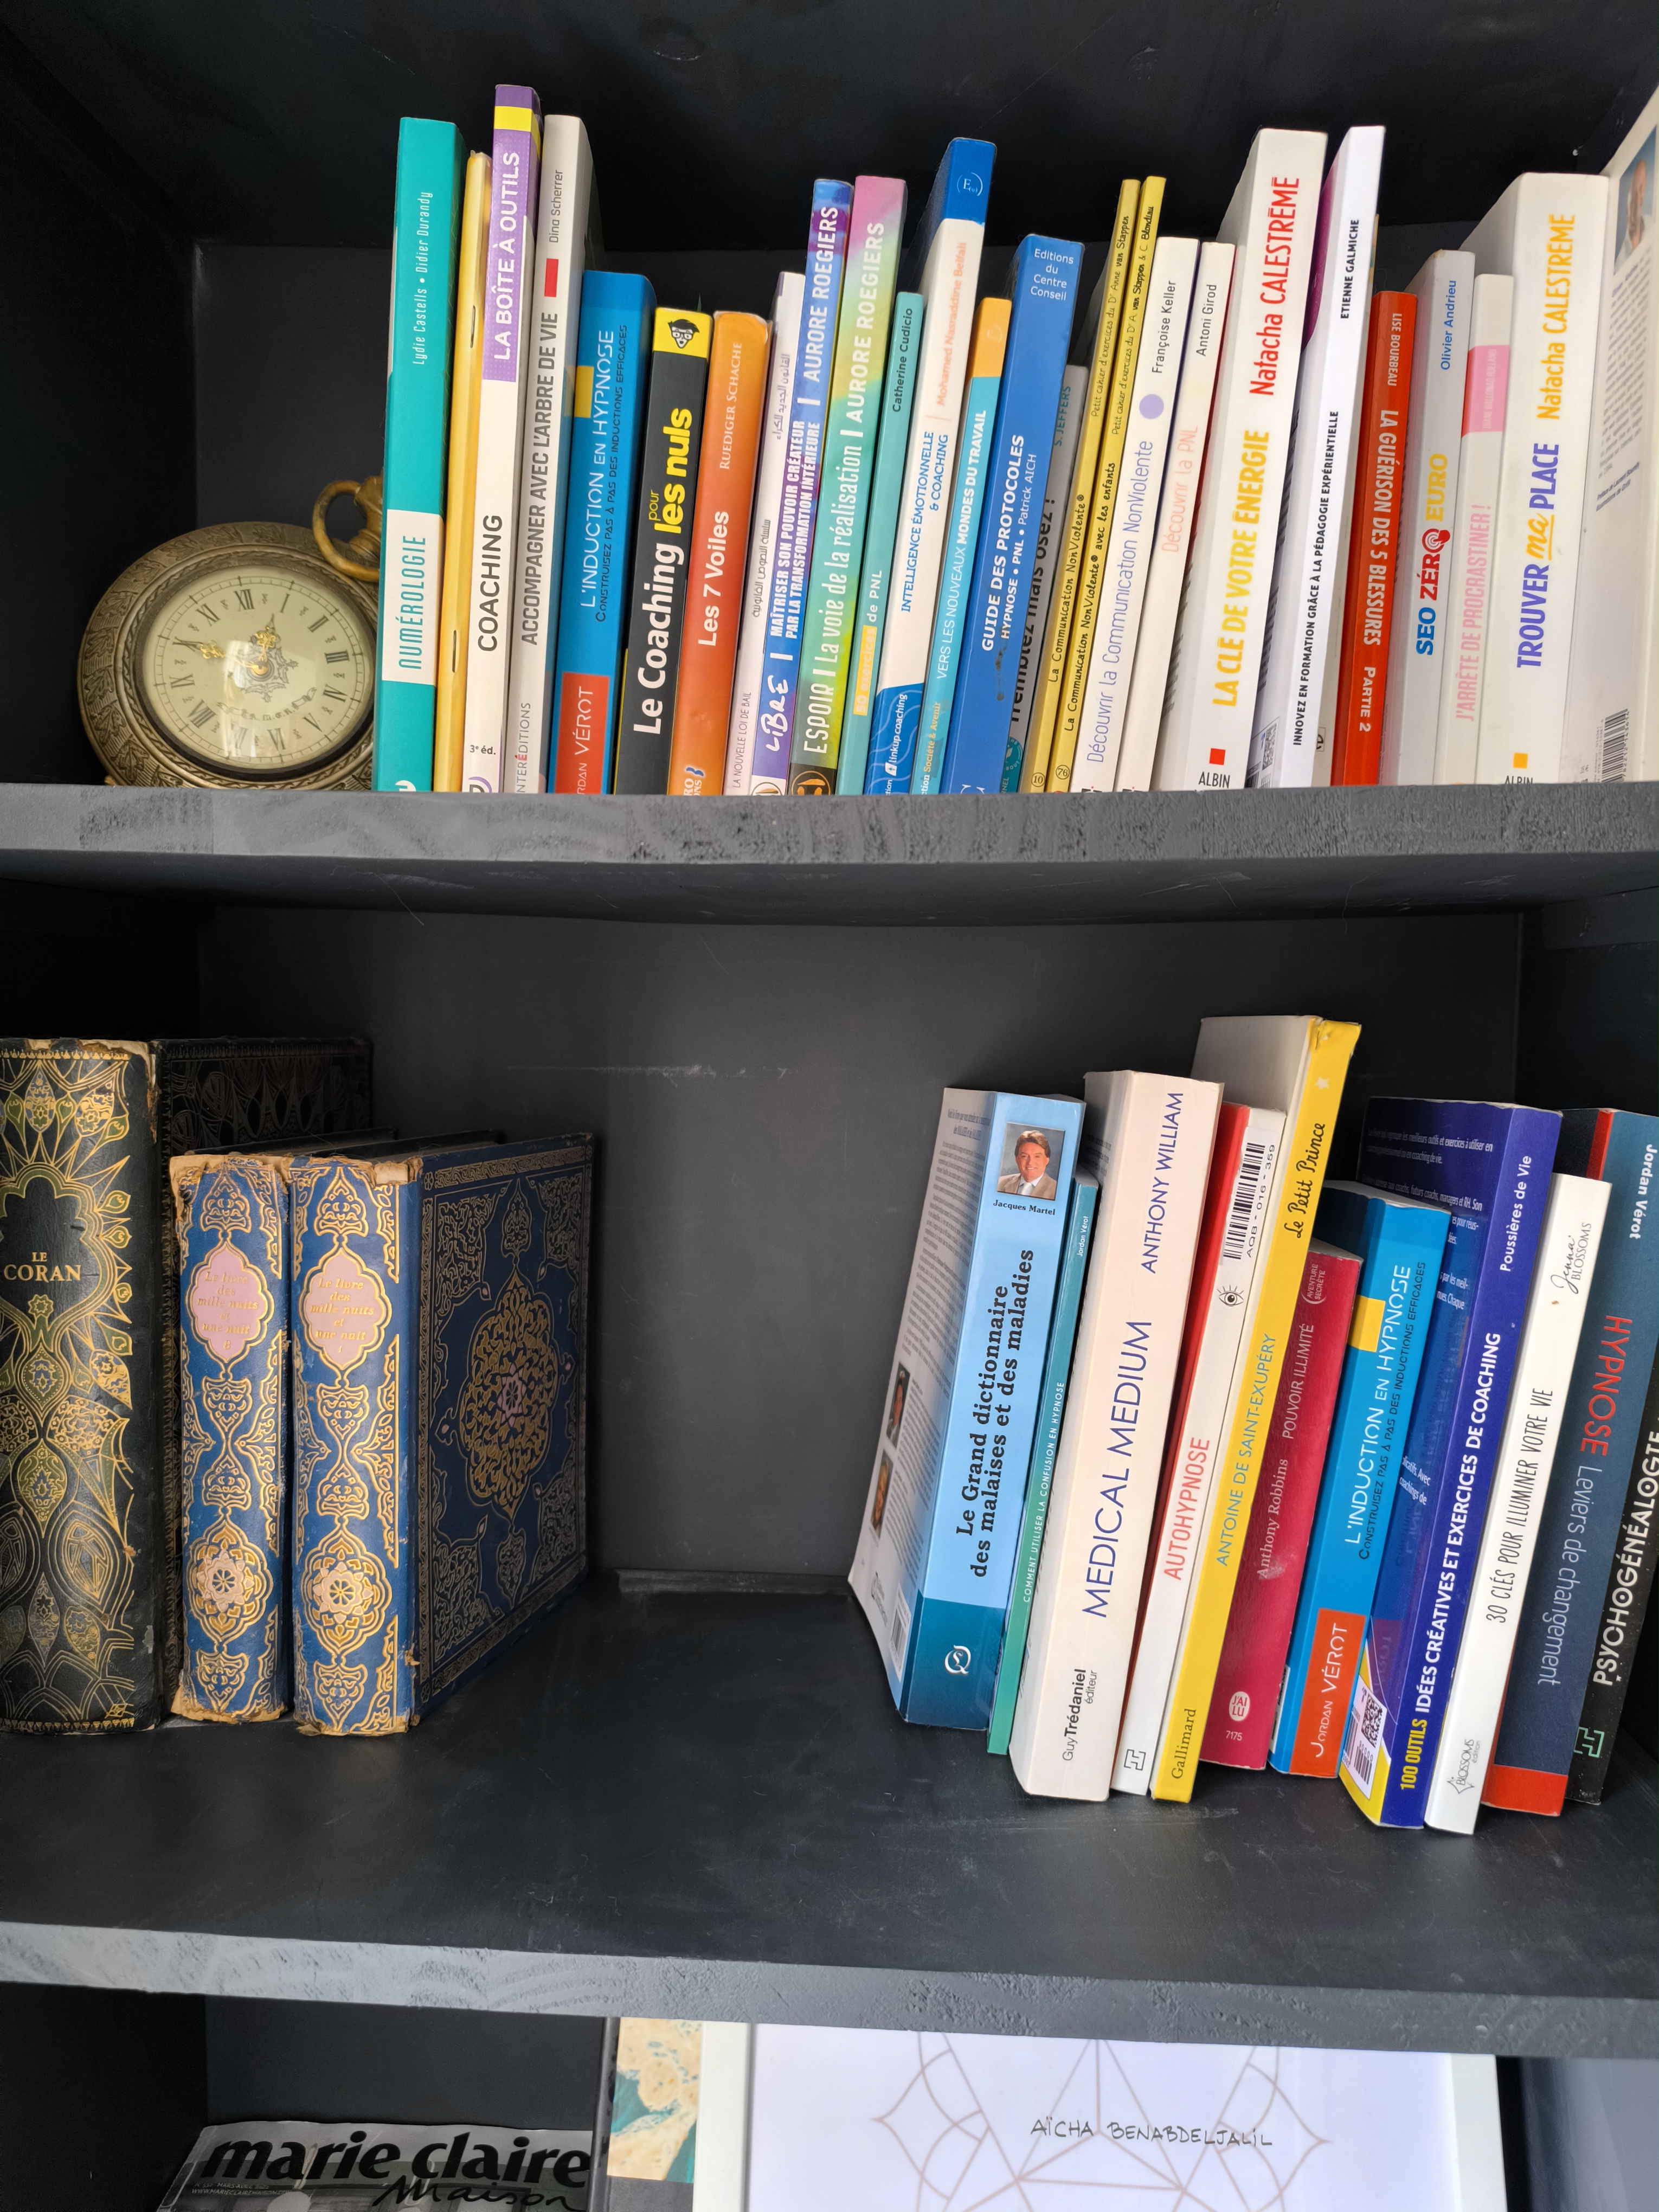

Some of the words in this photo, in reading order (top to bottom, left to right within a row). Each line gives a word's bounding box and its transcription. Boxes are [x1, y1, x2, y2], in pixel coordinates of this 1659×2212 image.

[499, 151, 519, 230] OUTILS
[551, 170, 563, 216] Scherrer
[417, 191, 433, 236] Durandy
[549, 220, 559, 243] Dina
[416, 240, 429, 273] Didier
[493, 238, 515, 254] À
[1034, 248, 1074, 264] Editions
[1345, 220, 1359, 273] GALMICHE
[856, 222, 884, 329] ROEGIERS
[1033, 274, 1067, 288] Centre
[1046, 264, 1058, 274] du
[414, 287, 427, 333] Castells
[492, 258, 514, 325] BOÎTE
[1031, 286, 1067, 301] Conseil
[1161, 280, 1175, 313] Keller
[1201, 284, 1217, 314] Girod
[1341, 276, 1353, 319] ETIENNE
[1443, 280, 1457, 327] Andrieu
[899, 308, 912, 351] Cudicio
[1195, 317, 1211, 357] Antoni
[1389, 312, 1403, 332] LISE
[413, 336, 425, 365] Lydie
[494, 332, 510, 361] LA
[1152, 316, 1171, 374] Françoise
[1387, 335, 1401, 387] BOURBEAU
[1441, 331, 1453, 371] Olivier
[593, 330, 614, 436] HYPNOSE
[847, 336, 872, 423] AURORE
[892, 356, 907, 412] Catherine
[1380, 410, 1399, 427] LA
[594, 443, 606, 465] EN
[664, 408, 692, 477] nuls
[1321, 411, 1338, 494] EXPÉRIENTIELLE
[1373, 433, 1400, 512] GUÉRISON
[1529, 443, 1559, 509] PLACE
[648, 490, 660, 520] pour
[654, 483, 685, 534] les
[581, 472, 604, 608] L'INDUCTION
[704, 511, 730, 579] Voiles
[1314, 498, 1329, 556] PÉDAGOGIE
[1371, 517, 1391, 545] DES
[1526, 512, 1551, 560] ma
[1313, 560, 1322, 573] LA
[1370, 550, 1387, 560] 5
[1416, 607, 1436, 655] SEO
[1426, 454, 1448, 522] EURO
[478, 515, 503, 651] COACHING
[704, 583, 721, 597] 7
[1306, 586, 1319, 619] GRÂCE
[638, 543, 683, 690] Coaching
[698, 605, 719, 646] Les
[1364, 564, 1387, 646] BLESSURES
[1517, 564, 1549, 668] TROUVER
[1300, 621, 1314, 681] FORMATION
[742, 692, 751, 708] BAIL
[1299, 684, 1308, 698] EN
[1360, 666, 1376, 718] PARTIE
[634, 698, 663, 735] Le
[738, 721, 748, 735] LOI
[740, 709, 748, 718] DE
[1293, 700, 1306, 745] INNOVEZ
[1359, 722, 1371, 732] 2
[734, 737, 746, 776] NOUVELLE
[732, 776, 742, 788] LA
[1198, 770, 1230, 788] ALBIN
[1155, 1092, 1184, 1170] WILLIAM
[1296, 1122, 1326, 1173] Prince
[1517, 1155, 1532, 1178] Vie
[1638, 1143, 1658, 1195] Jordan
[993, 1199, 1026, 1212] Jacques
[1028, 1205, 1056, 1216] Martel
[1288, 1180, 1313, 1215] Petit
[1514, 1181, 1527, 1199] de
[1076, 1234, 1086, 1257] Jordan
[1081, 1216, 1089, 1232] Vérot
[1141, 1177, 1170, 1275] ANTHONY
[1284, 1220, 1303, 1239] Le
[1501, 1202, 1522, 1272] Poussières
[1629, 1200, 1648, 1239] Vérot
[31, 1252, 48, 1263] LE
[1571, 1221, 1592, 1281] BLOSSOMS
[3, 1265, 81, 1282] CORAN
[330, 1293, 350, 1301] des
[1007, 1250, 1034, 1352] maladies
[973, 1285, 1008, 1425] dictionnaire
[1293, 1323, 1316, 1376] ILLIMITÉ
[997, 1359, 1018, 1396] des
[1239, 1333, 1276, 1457] SAINT-EXUPÉRY
[1472, 1333, 1501, 1424] COACHING
[1529, 1388, 1553, 1409] VIE
[1580, 1315, 1632, 1457] HYPNOSE
[996, 1404, 1010, 1427] et
[1051, 1381, 1064, 1424] HYPNOSE
[1283, 1379, 1304, 1440] POUVOIR
[1049, 1427, 1058, 1440] EN
[1465, 1426, 1483, 1449] DE
[1521, 1413, 1548, 1453] VOTRE
[961, 1433, 987, 1501] Grand
[981, 1434, 1007, 1532] malaises
[1040, 1443, 1055, 1497] CONFUSION
[1082, 1467, 1129, 1619] MEDICAL
[1106, 1321, 1152, 1458] MEDIUM
[1232, 1463, 1247, 1486] DE
[1037, 1500, 1046, 1512] LA
[1163, 1437, 1210, 1581] AUTOHYPNOSE
[1448, 1454, 1478, 1545] EXERCICES
[1505, 1459, 1539, 1528] ILLUMINER
[1567, 1465, 1603, 1535] Leviers
[956, 1510, 975, 1535] Le
[1031, 1515, 1042, 1553] UTILISER
[1216, 1489, 1243, 1566] ANTOINE
[1257, 1517, 1279, 1579] Anthony
[1268, 1458, 1288, 1514] Robbins
[970, 1540, 991, 1577] des
[1443, 1546, 1459, 1569] ET
[1498, 1530, 1523, 1567] POUR
[1561, 1536, 1588, 1564] de
[1024, 1557, 1037, 1603] COMMENT
[1492, 1569, 1517, 1599] CLÉS
[1425, 1572, 1455, 1663] CRÉATIVES
[1486, 1604, 1507, 1624] 30
[1537, 1569, 1583, 1686] changement
[1415, 1665, 1437, 1713] IDÉES
[1171, 1707, 1197, 1780] Gallimard
[1226, 1730, 1243, 1741] 7175
[1403, 1718, 1427, 1762] OUTILS
[1400, 1764, 1417, 1791] 100
[201, 2130, 400, 2181] marie
[410, 2132, 590, 2184] claire
